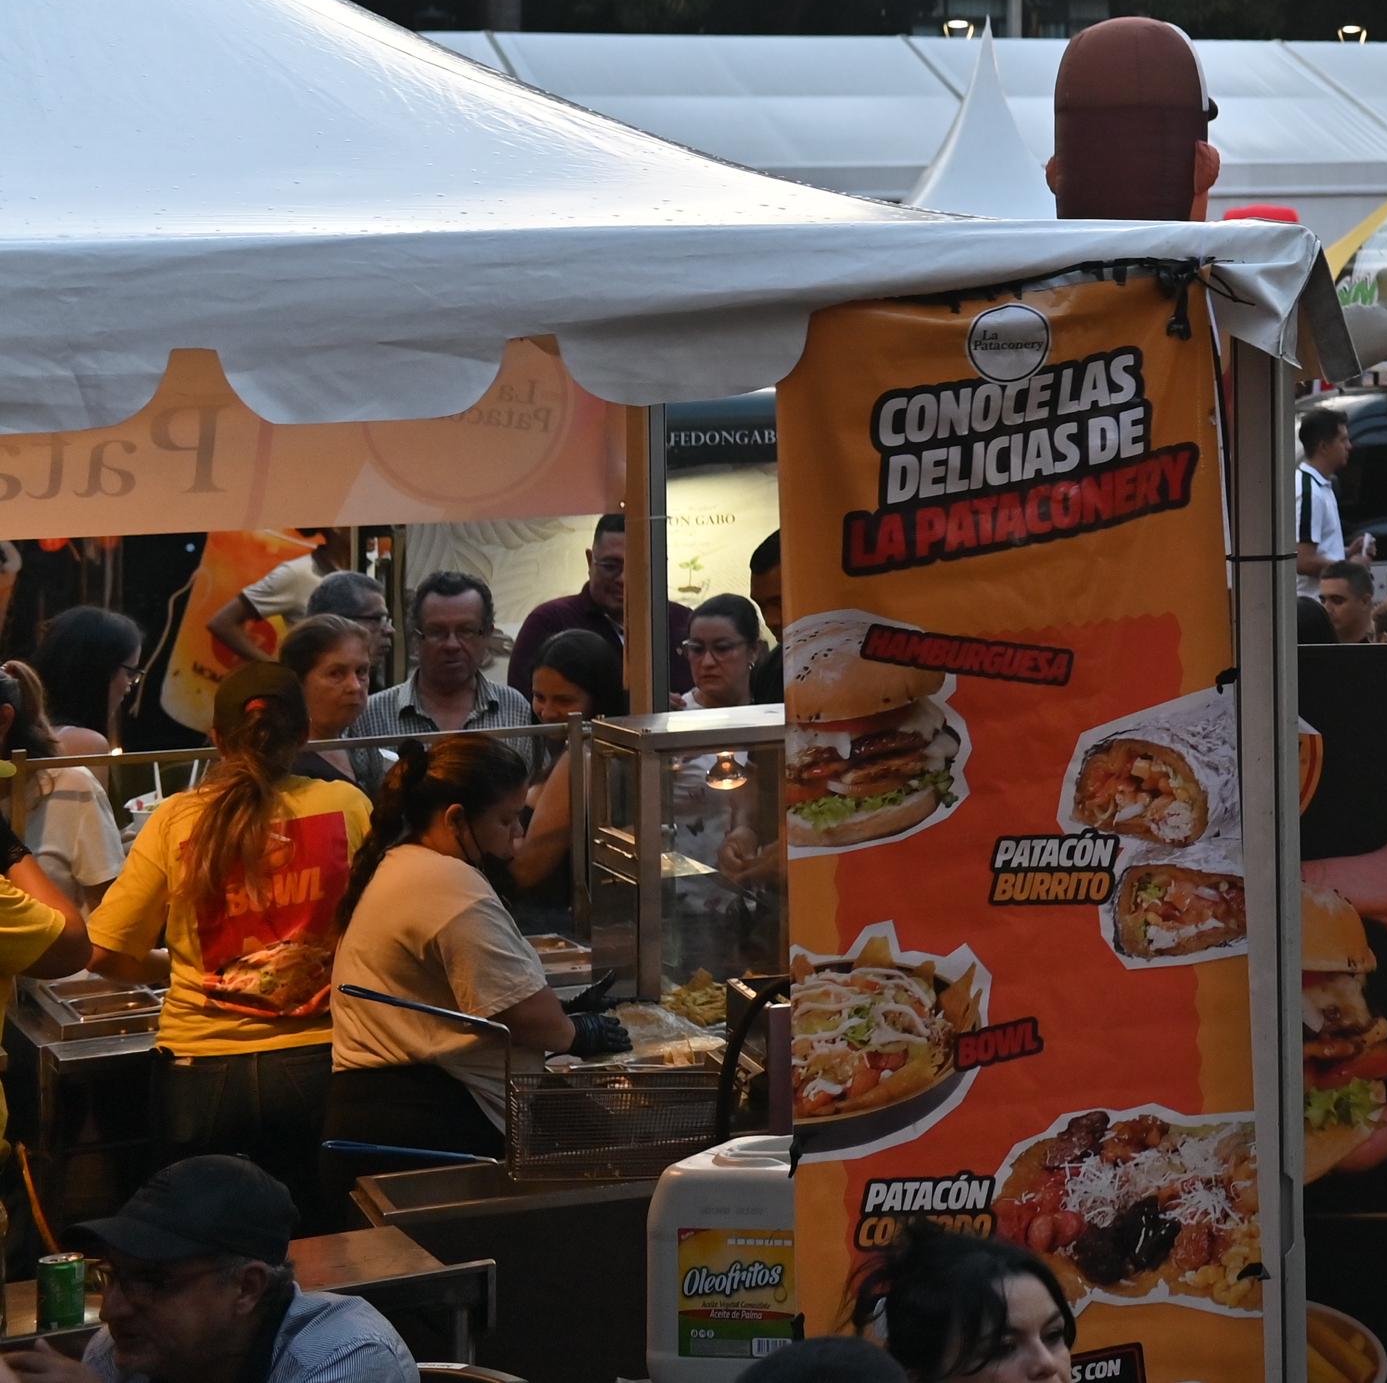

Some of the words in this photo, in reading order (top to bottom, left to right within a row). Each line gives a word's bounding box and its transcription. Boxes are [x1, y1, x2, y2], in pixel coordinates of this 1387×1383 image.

[973, 340, 1044, 352] Pataconery
[982, 330, 999, 341] La
[878, 373, 1054, 447] CONOCE
[1057, 354, 1136, 416] LAS
[887, 421, 1080, 504] DELICIAS
[1088, 407, 1145, 466] DE
[851, 512, 906, 566] LA
[915, 450, 1193, 558] PATACONERY
[866, 628, 1073, 682] HAMBURGUESA
[994, 833, 1115, 868] PATACÓN
[993, 871, 1111, 902] BURRITO
[958, 1022, 1038, 1066] BOWL
[865, 1174, 991, 1213] PATACÓN
[858, 1216, 897, 1247] CO
[683, 1262, 783, 1297] Oleofritos
[709, 1310, 731, 1319] Aceite
[732, 1311, 739, 1319] de
[740, 1311, 763, 1320] Palma
[1085, 1359, 1121, 1381] CON
